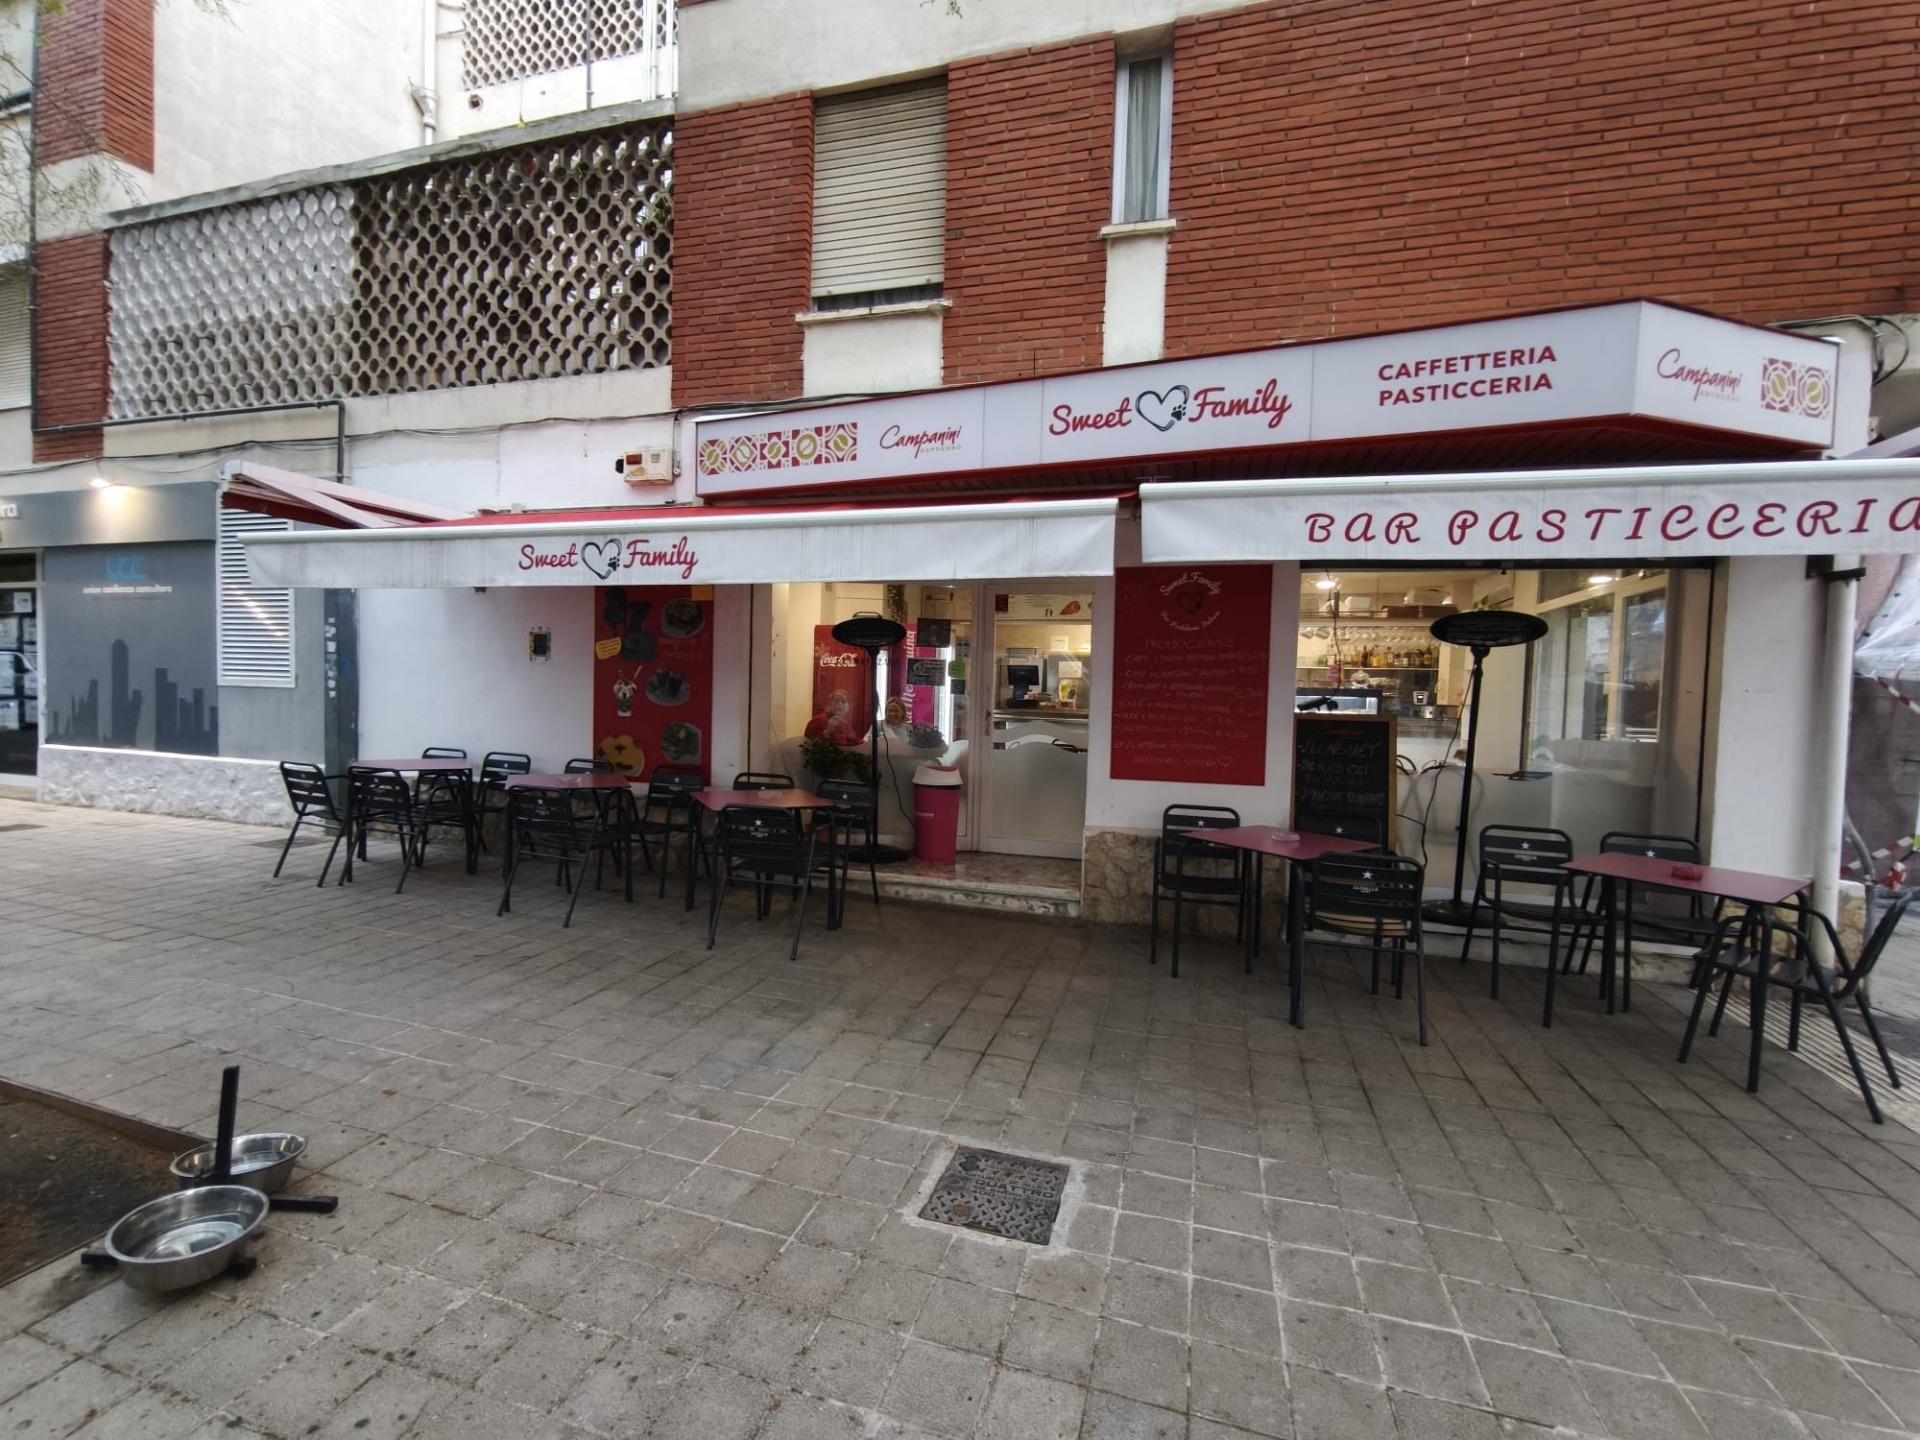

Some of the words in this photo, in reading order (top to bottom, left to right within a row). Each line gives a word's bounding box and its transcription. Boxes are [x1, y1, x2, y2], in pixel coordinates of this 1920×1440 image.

[1378, 345, 1557, 381] CAFFETTERIA
[1656, 348, 1744, 402] Campanini
[1048, 397, 1133, 436] Sweet
[1188, 378, 1293, 429] Family
[1378, 372, 1553, 407] PASTICCERIA
[879, 424, 963, 459] Campanini
[1304, 510, 1421, 546] BAR
[1446, 496, 1920, 546] PASTICCERIA
[518, 542, 579, 571] Sweet
[623, 535, 699, 580] Family
[975, 1179, 1055, 1198] QUATTRO
